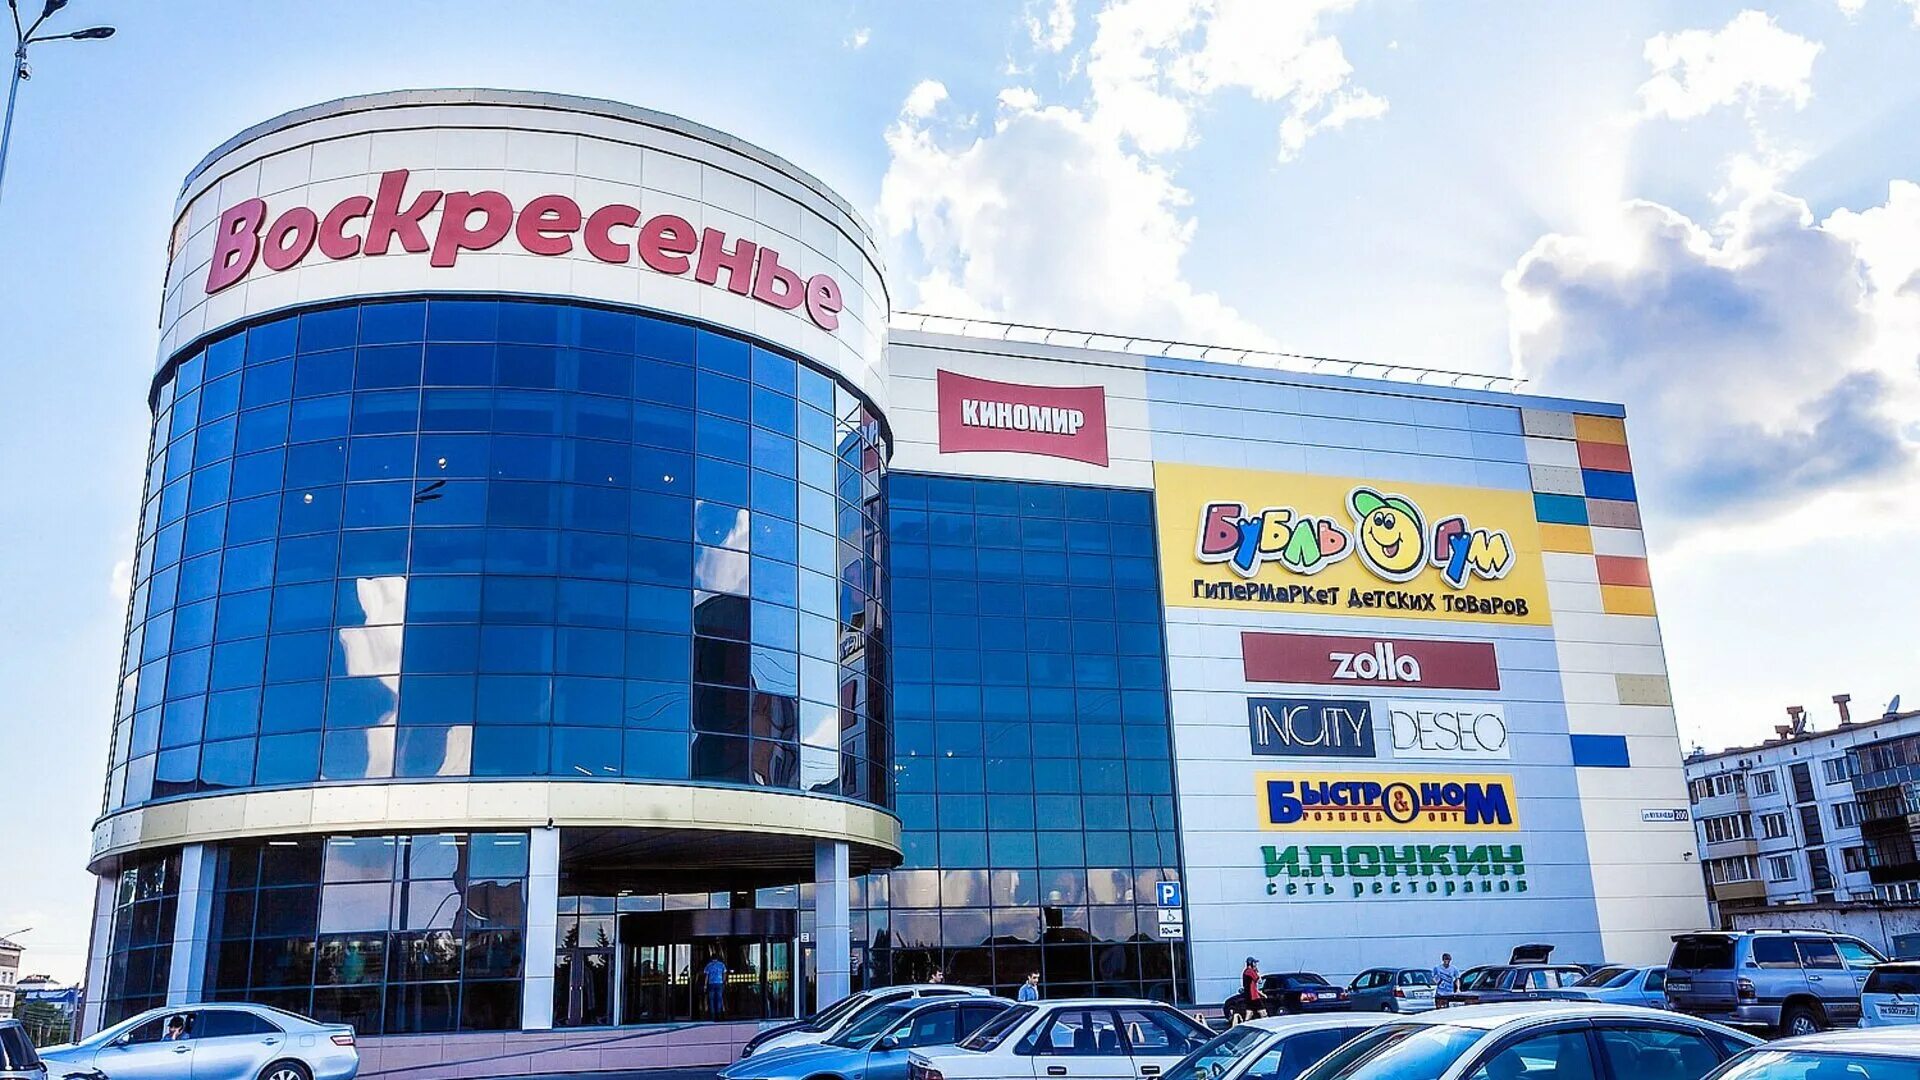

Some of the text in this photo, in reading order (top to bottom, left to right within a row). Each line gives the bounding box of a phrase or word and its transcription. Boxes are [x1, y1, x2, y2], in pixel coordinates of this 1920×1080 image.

[205, 169, 843, 331] Воскресенье
[961, 398, 1085, 436] КИНОМИР
[1329, 641, 1422, 683] zolla
[1255, 704, 1368, 747] INCITY
[1389, 709, 1507, 752] DESEO
[1260, 845, 1526, 878] И.ПОНКИН
[1163, 885, 1174, 904] P
[1266, 879, 1528, 898] сеть ресторанов
